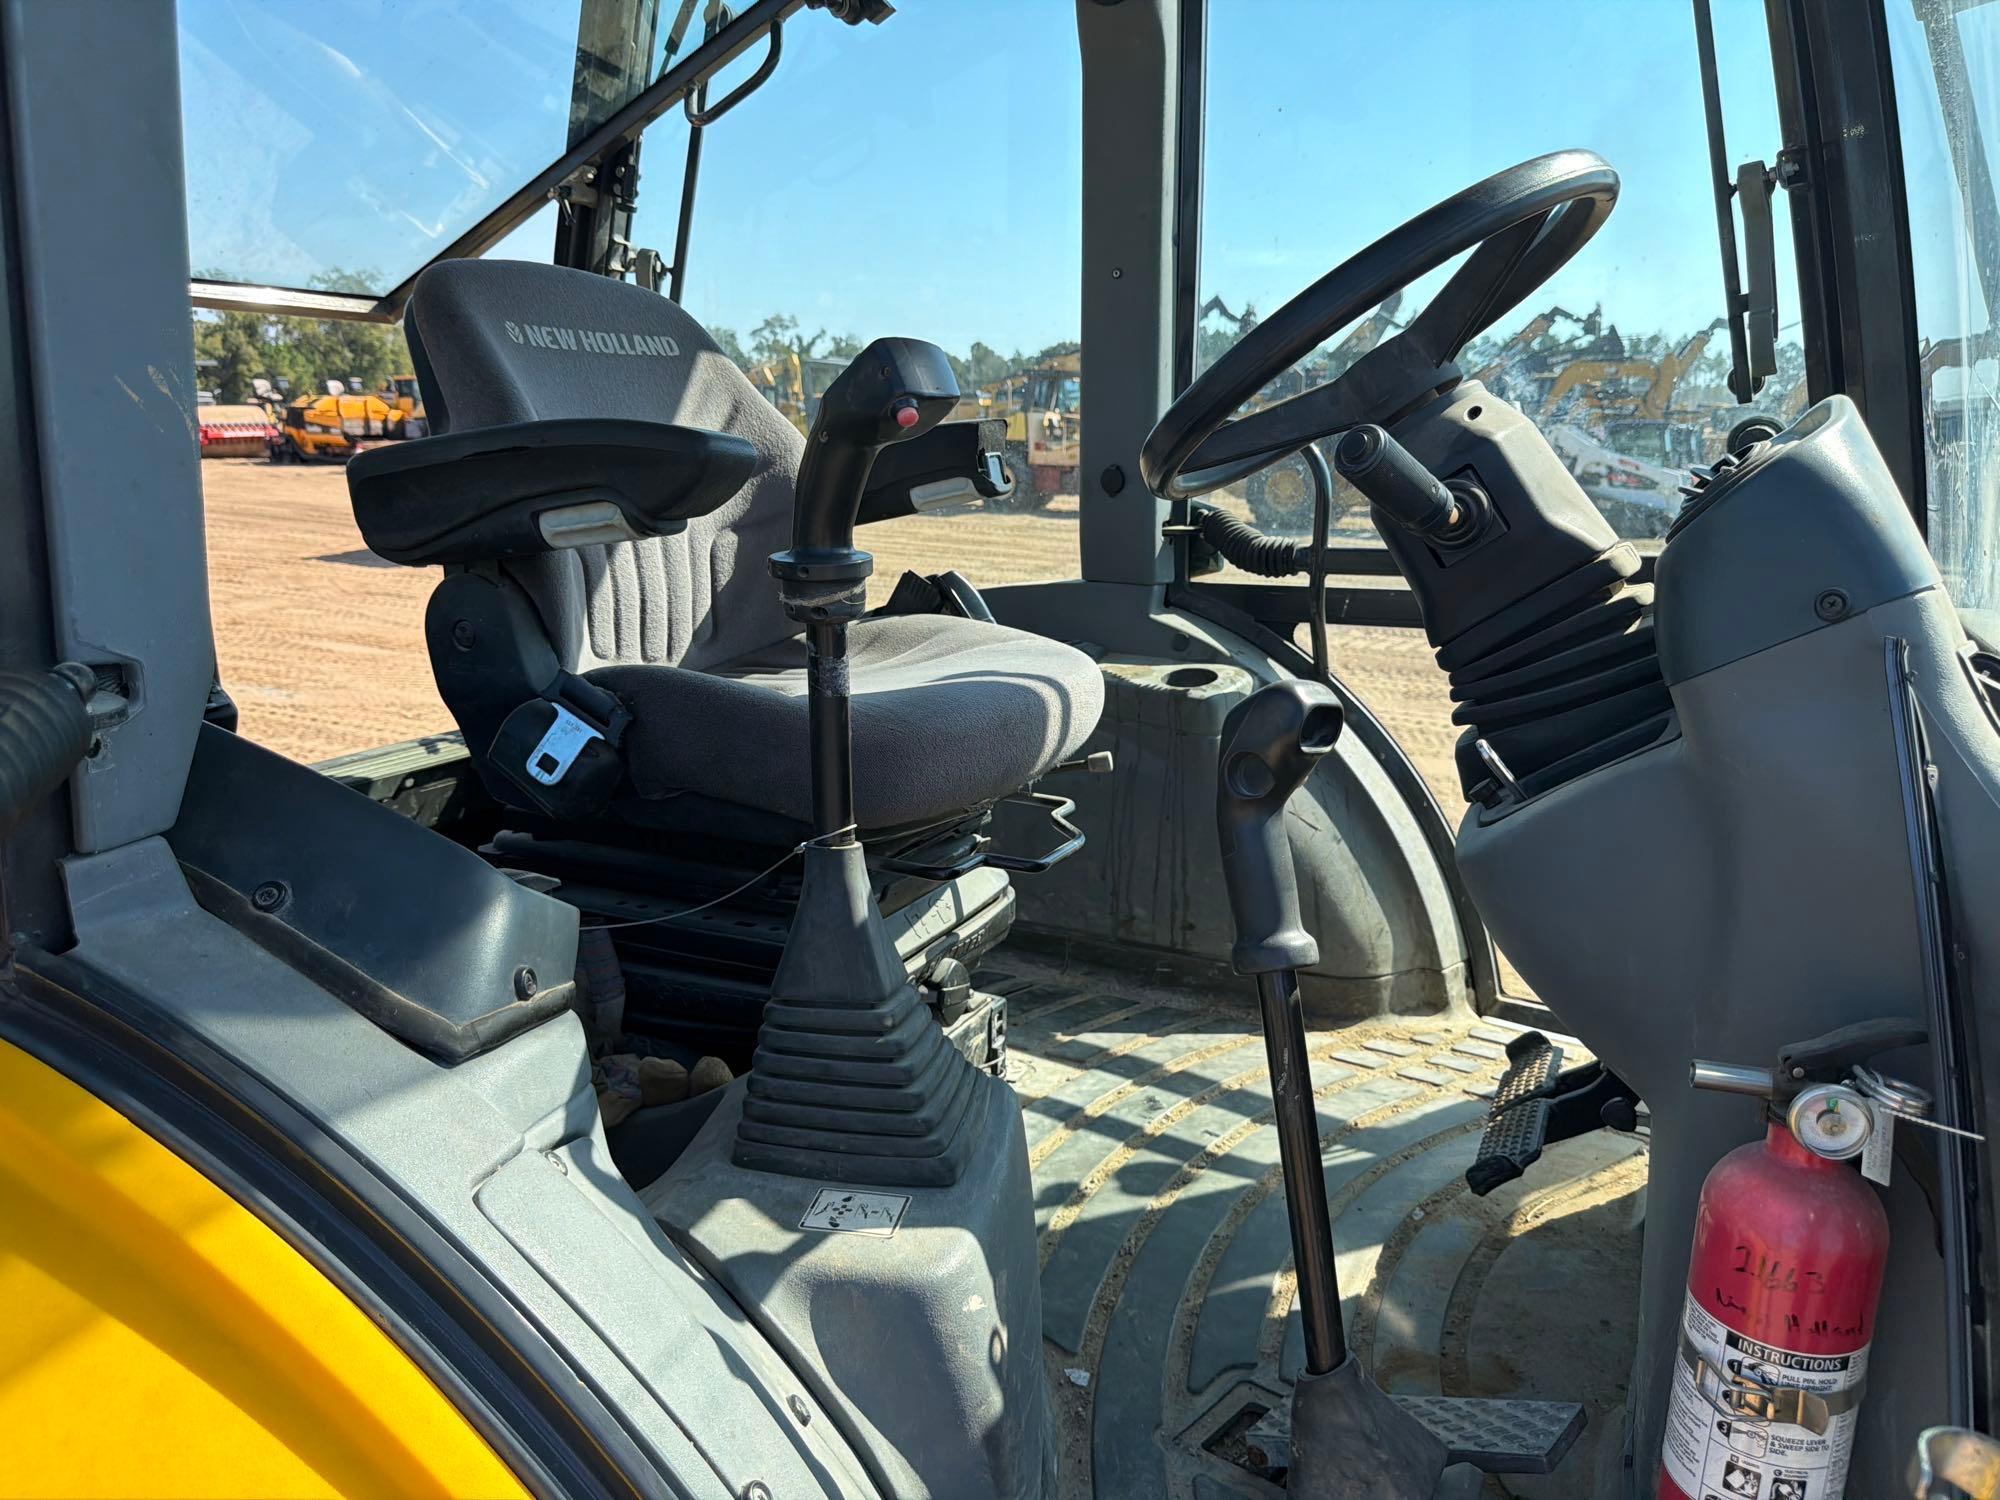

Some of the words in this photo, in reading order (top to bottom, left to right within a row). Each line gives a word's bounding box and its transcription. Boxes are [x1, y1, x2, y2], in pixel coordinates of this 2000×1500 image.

[523, 323, 578, 351] NEW
[578, 329, 680, 357] HOLLAND
[1737, 1338, 1842, 1371] INSTRUCTIONS
[1782, 1374, 1801, 1383] PULL
[1720, 1423, 1728, 1433] 3
[1770, 1434, 1805, 1445] SQUEEZE
[1768, 1447, 1787, 1456] SIDE.
[1777, 1442, 1804, 1451] SWEEP
